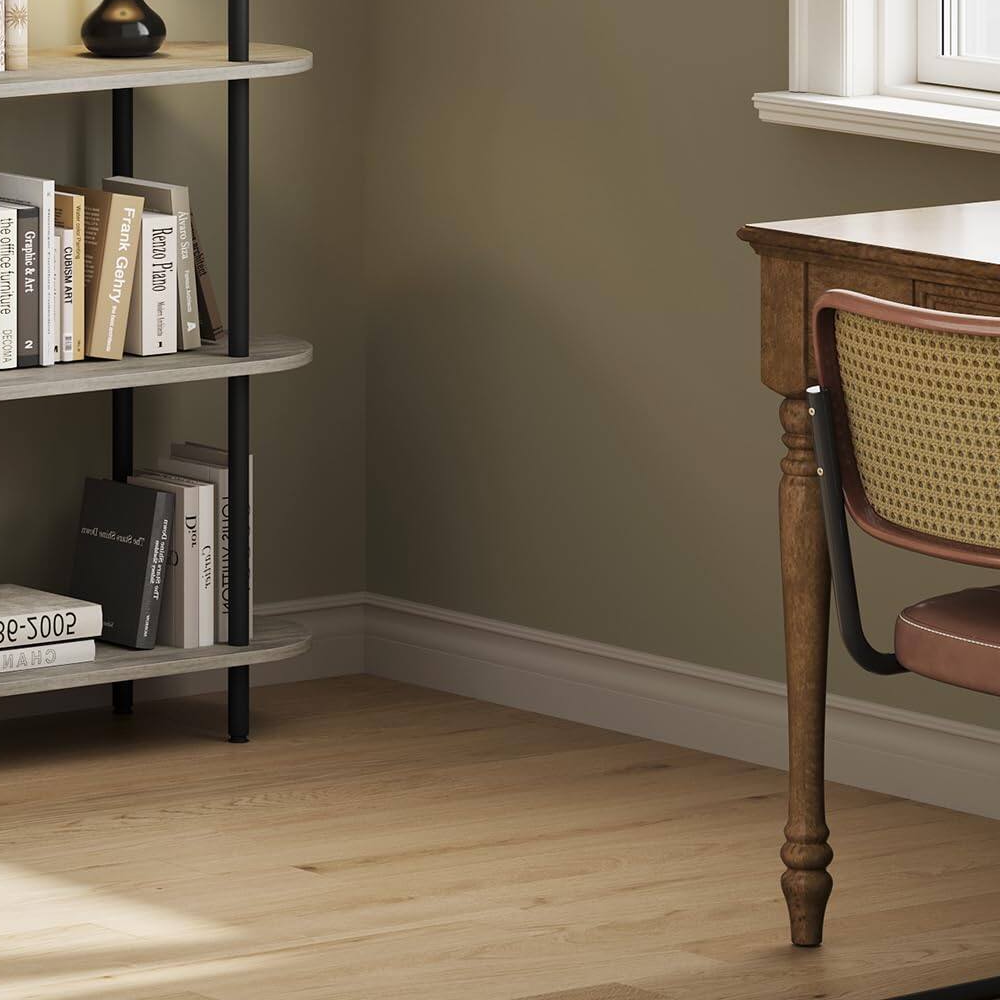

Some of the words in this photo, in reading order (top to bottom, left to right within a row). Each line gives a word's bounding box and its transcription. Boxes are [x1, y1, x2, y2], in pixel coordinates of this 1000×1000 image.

[119, 207, 136, 251] Frank
[153, 227, 173, 259] Renzo
[22, 231, 35, 265] Graphic
[64, 246, 73, 283] CUBISM
[25, 277, 35, 293] Art
[109, 256, 128, 304] Gehry
[153, 262, 173, 292] Piano
[64, 286, 73, 304] ART
[3, 330, 13, 363] DECOMA
